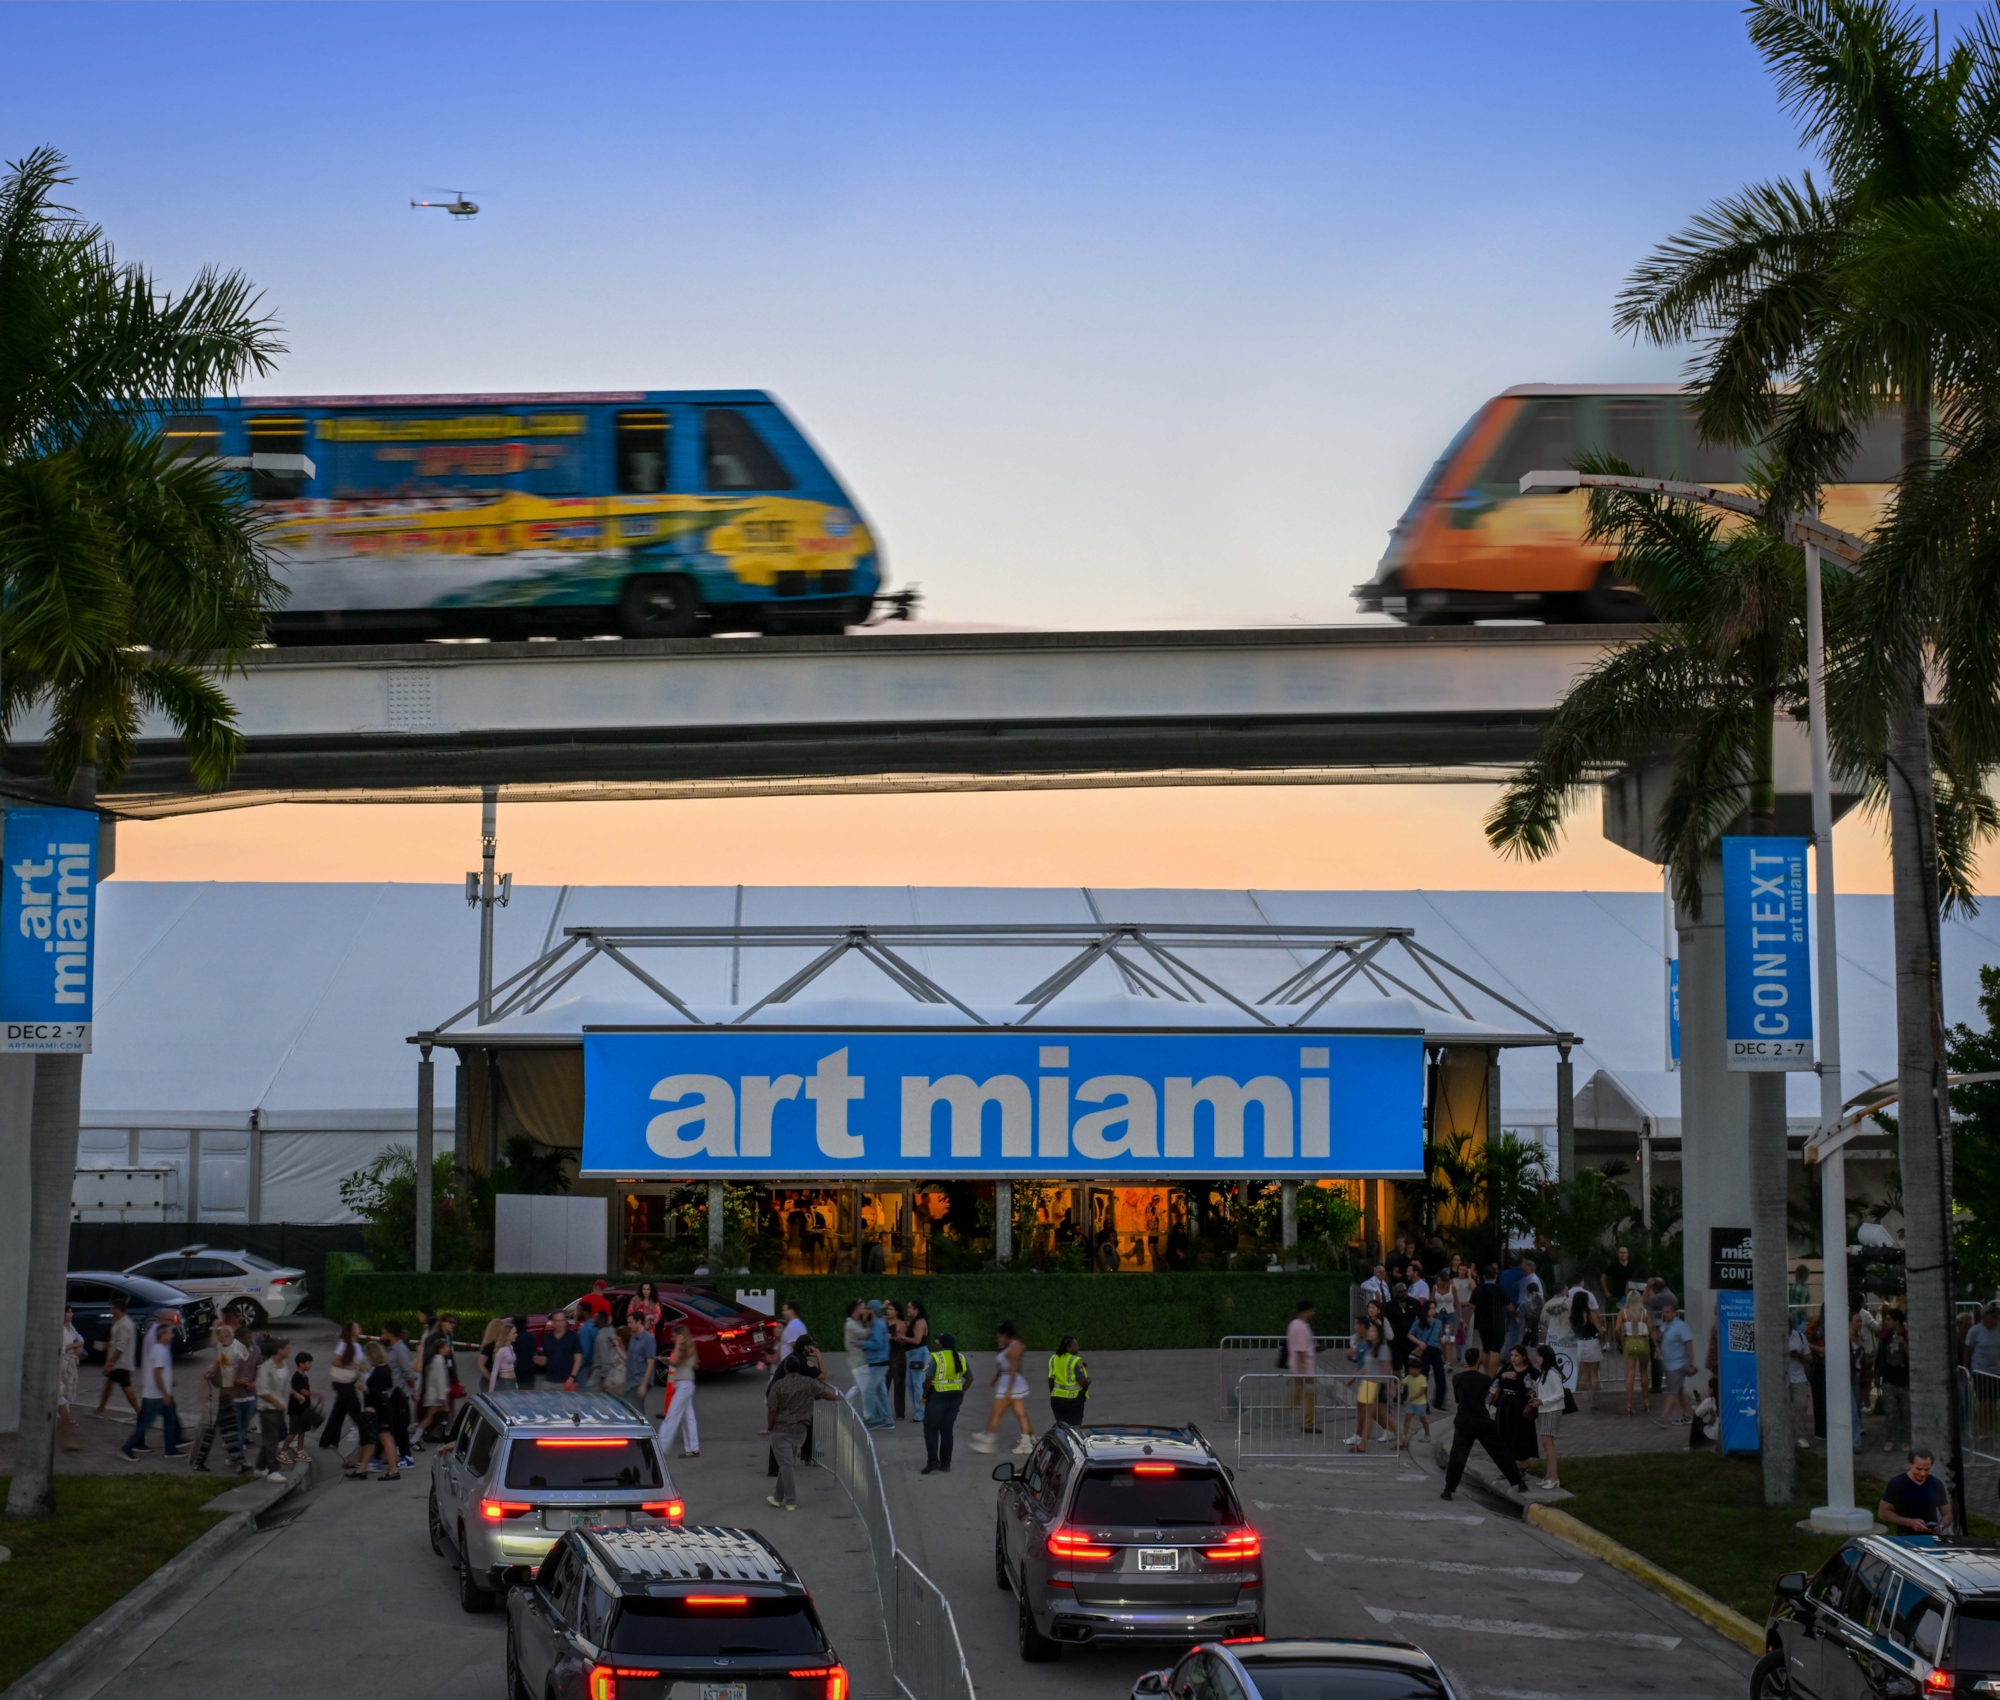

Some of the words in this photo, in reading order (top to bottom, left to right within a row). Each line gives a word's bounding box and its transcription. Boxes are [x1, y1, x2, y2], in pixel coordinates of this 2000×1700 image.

[1786, 855, 1803, 911] miami
[12, 859, 54, 939] art
[44, 843, 90, 1004] miami
[1790, 917, 1804, 944] art
[1751, 849, 1789, 1035] CONTEXT
[8, 1025, 48, 1039] DEC
[52, 1025, 62, 1039] 2
[75, 1025, 86, 1039] 7
[8, 1042, 82, 1050] ARTMIAMI.COM
[1734, 1042, 1767, 1055] DEC
[1773, 1043, 1783, 1056] 2
[1795, 1043, 1805, 1055] 7
[645, 1045, 866, 1159] art
[900, 1045, 1330, 1159] miami
[1721, 1245, 1753, 1259] mia
[1720, 1267, 1753, 1279] CONT
